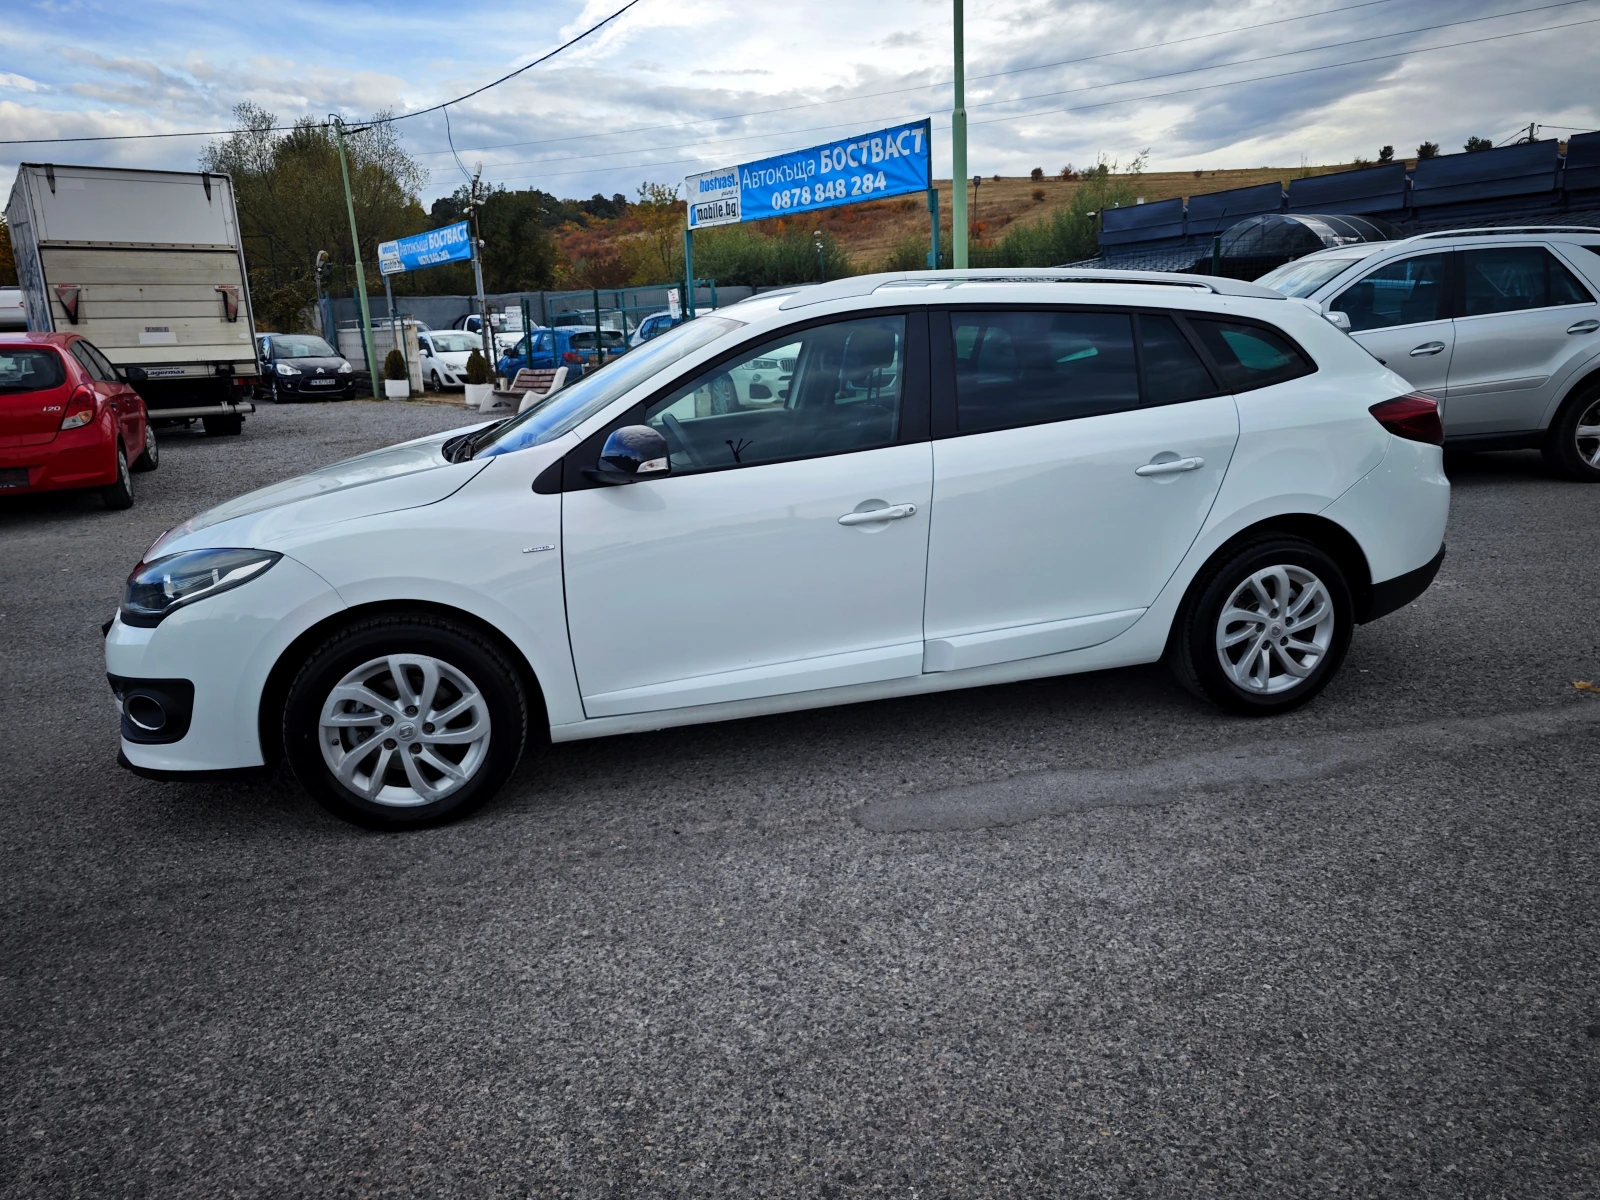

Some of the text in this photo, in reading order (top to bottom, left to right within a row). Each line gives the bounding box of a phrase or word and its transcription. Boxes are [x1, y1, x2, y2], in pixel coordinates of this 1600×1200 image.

[742, 127, 924, 191] Автокъща БОСТВАСТ
[771, 171, 887, 210] 0878 848 284
[697, 201, 737, 221] mobile.bg
[429, 224, 468, 249] БОСТВАСТ
